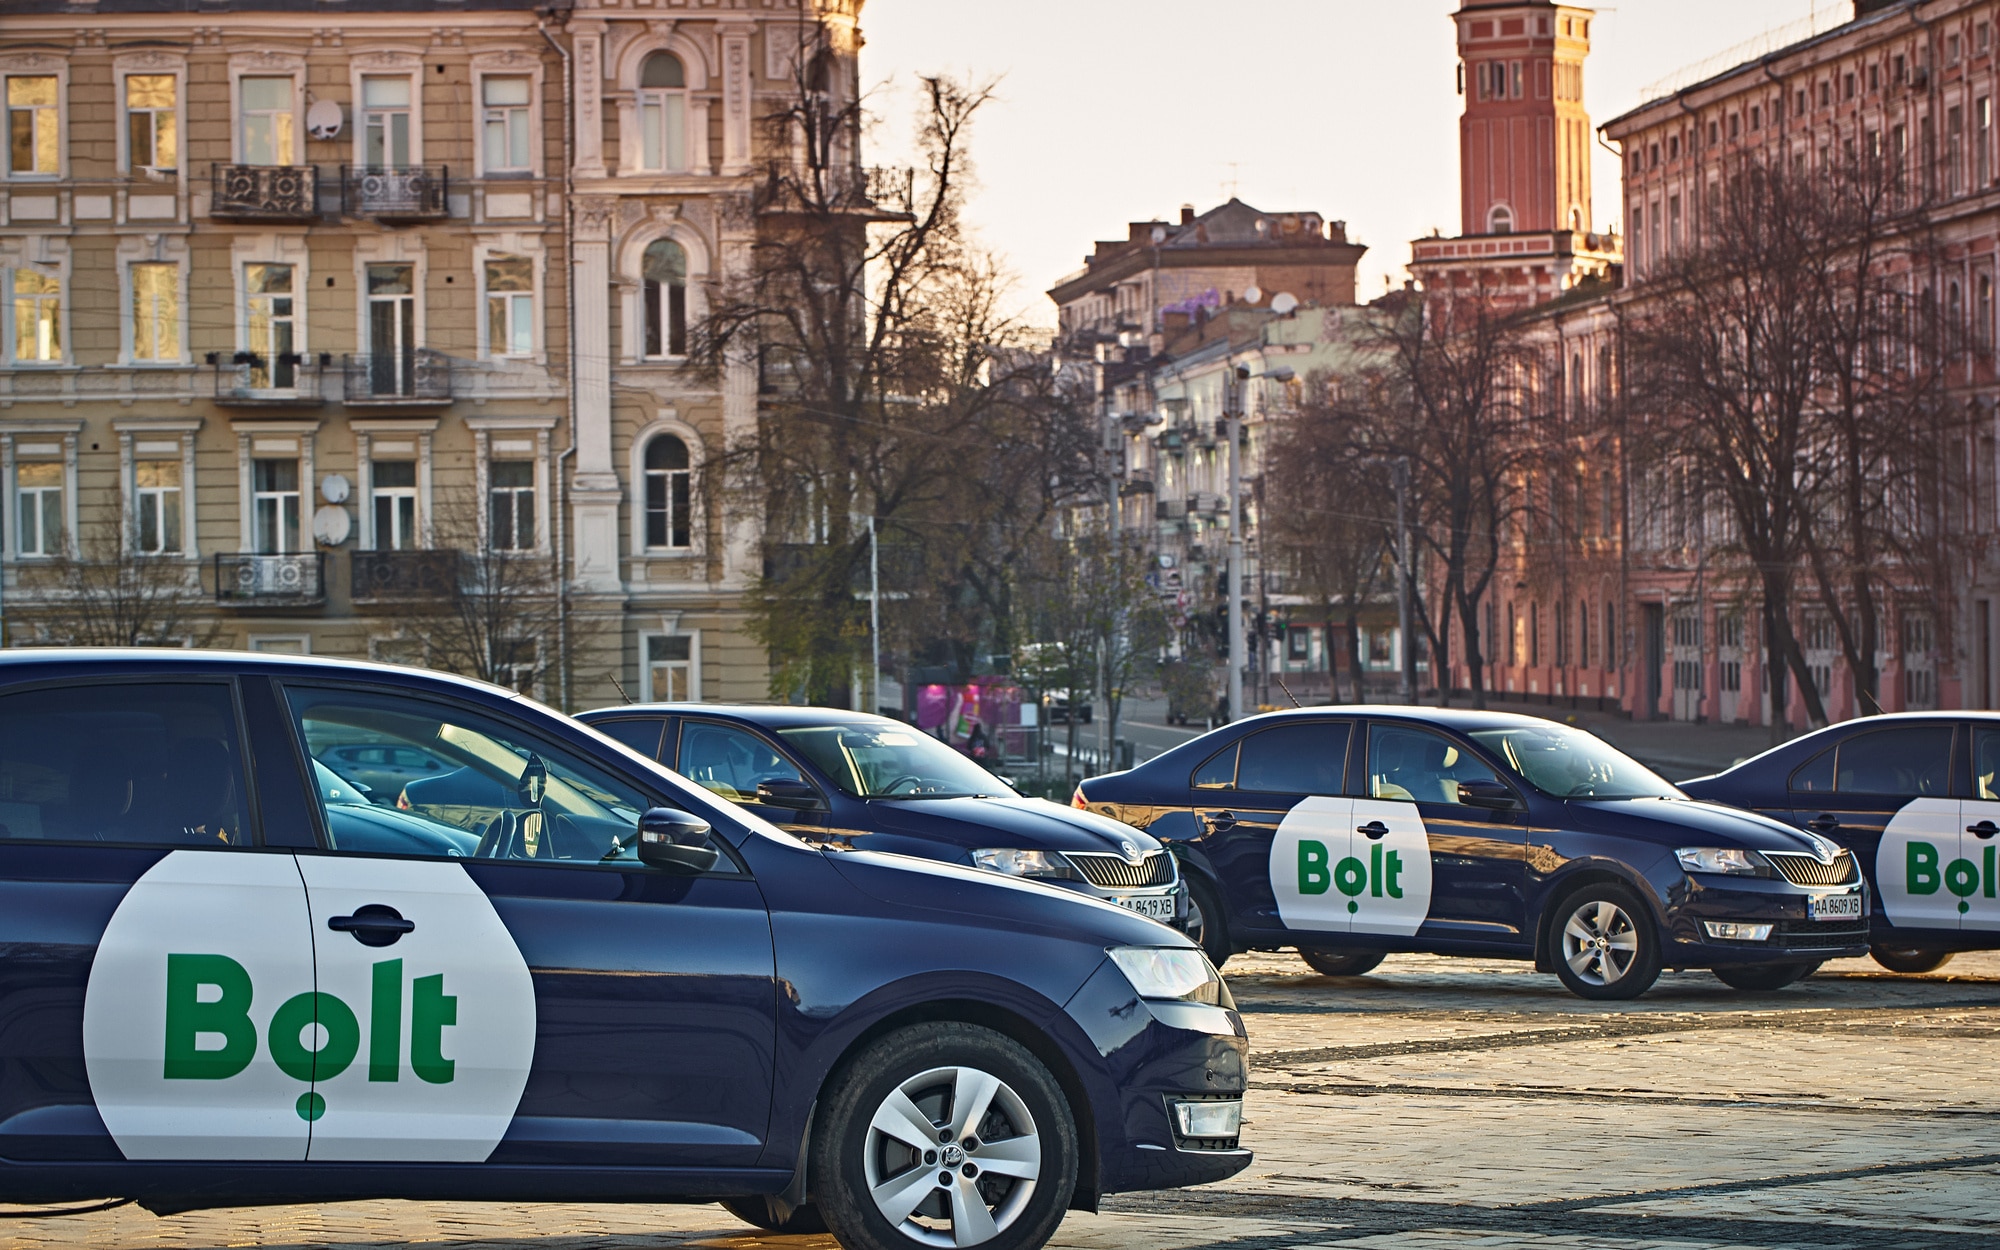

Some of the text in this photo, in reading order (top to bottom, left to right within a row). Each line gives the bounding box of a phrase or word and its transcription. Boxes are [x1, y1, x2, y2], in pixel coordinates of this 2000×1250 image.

[1136, 900, 1158, 915] 8619
[1298, 839, 1403, 914] Bolt
[1814, 899, 1828, 914] AA
[1829, 899, 1848, 914] 8609
[1905, 841, 2000, 914] Bol
[163, 953, 458, 1122] Bolt
